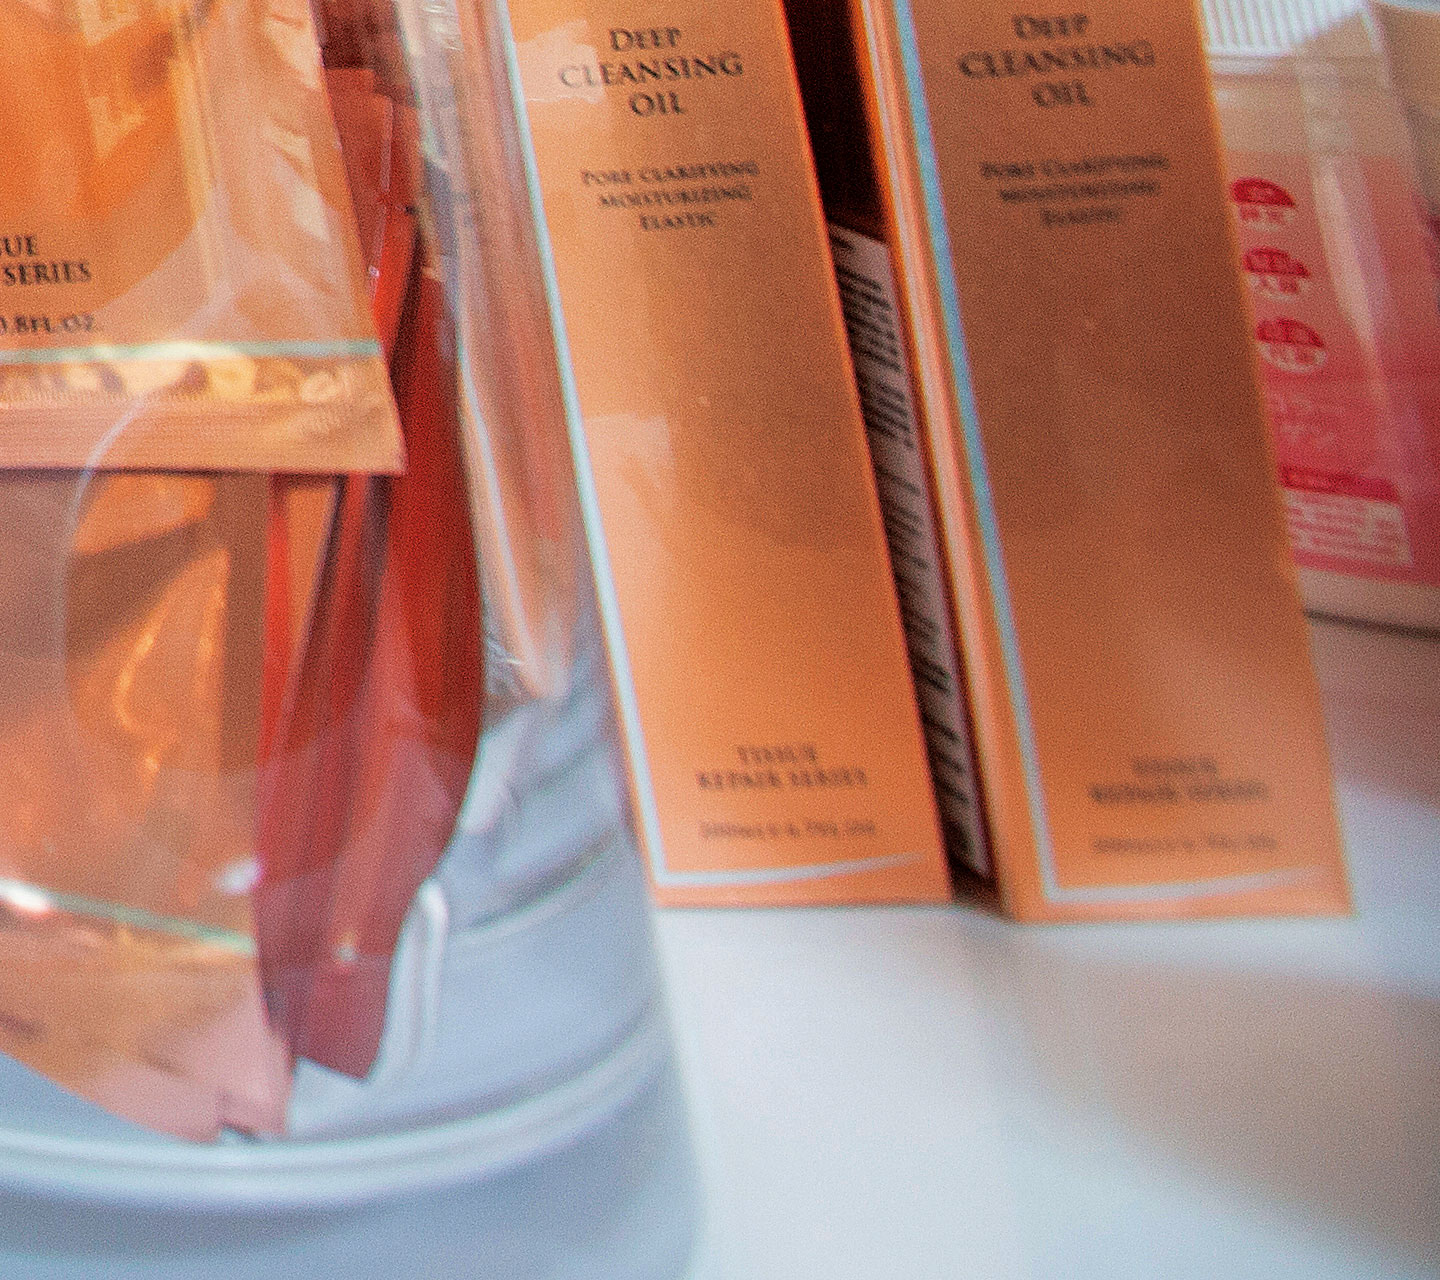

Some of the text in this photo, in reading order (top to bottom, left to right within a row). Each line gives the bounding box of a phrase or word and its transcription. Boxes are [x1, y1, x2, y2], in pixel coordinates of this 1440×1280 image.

[609, 26, 682, 52] DEEP
[560, 50, 744, 89] CLEANSING
[958, 40, 1157, 79] CLEANSING
[629, 91, 685, 118] OIL
[3, 260, 92, 287] SERIES
